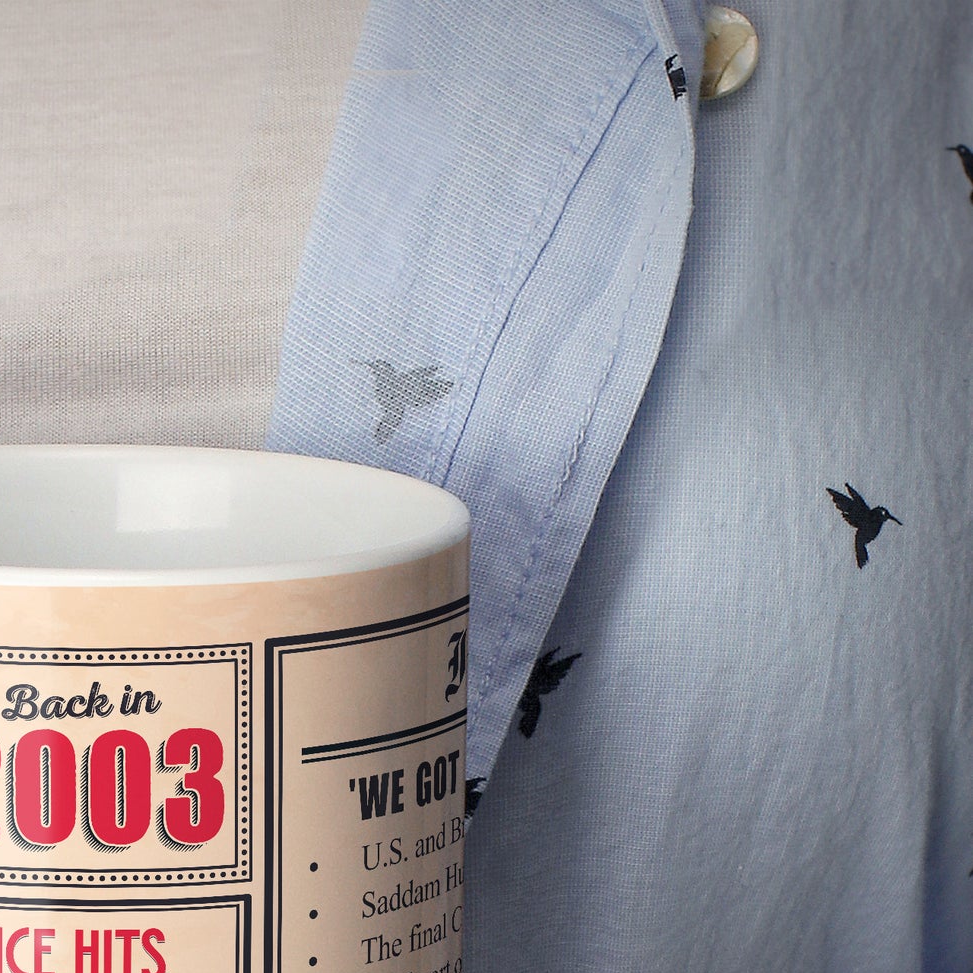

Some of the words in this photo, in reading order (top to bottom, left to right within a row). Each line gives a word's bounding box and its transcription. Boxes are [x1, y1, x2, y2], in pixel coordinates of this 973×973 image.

[1, 682, 114, 721] Back
[120, 683, 162, 715] in
[416, 750, 460, 808] GOT
[362, 837, 408, 870] U.S.
[415, 822, 445, 858] and
[362, 880, 440, 919] Saddam
[361, 935, 402, 965] The
[409, 913, 446, 953] final
